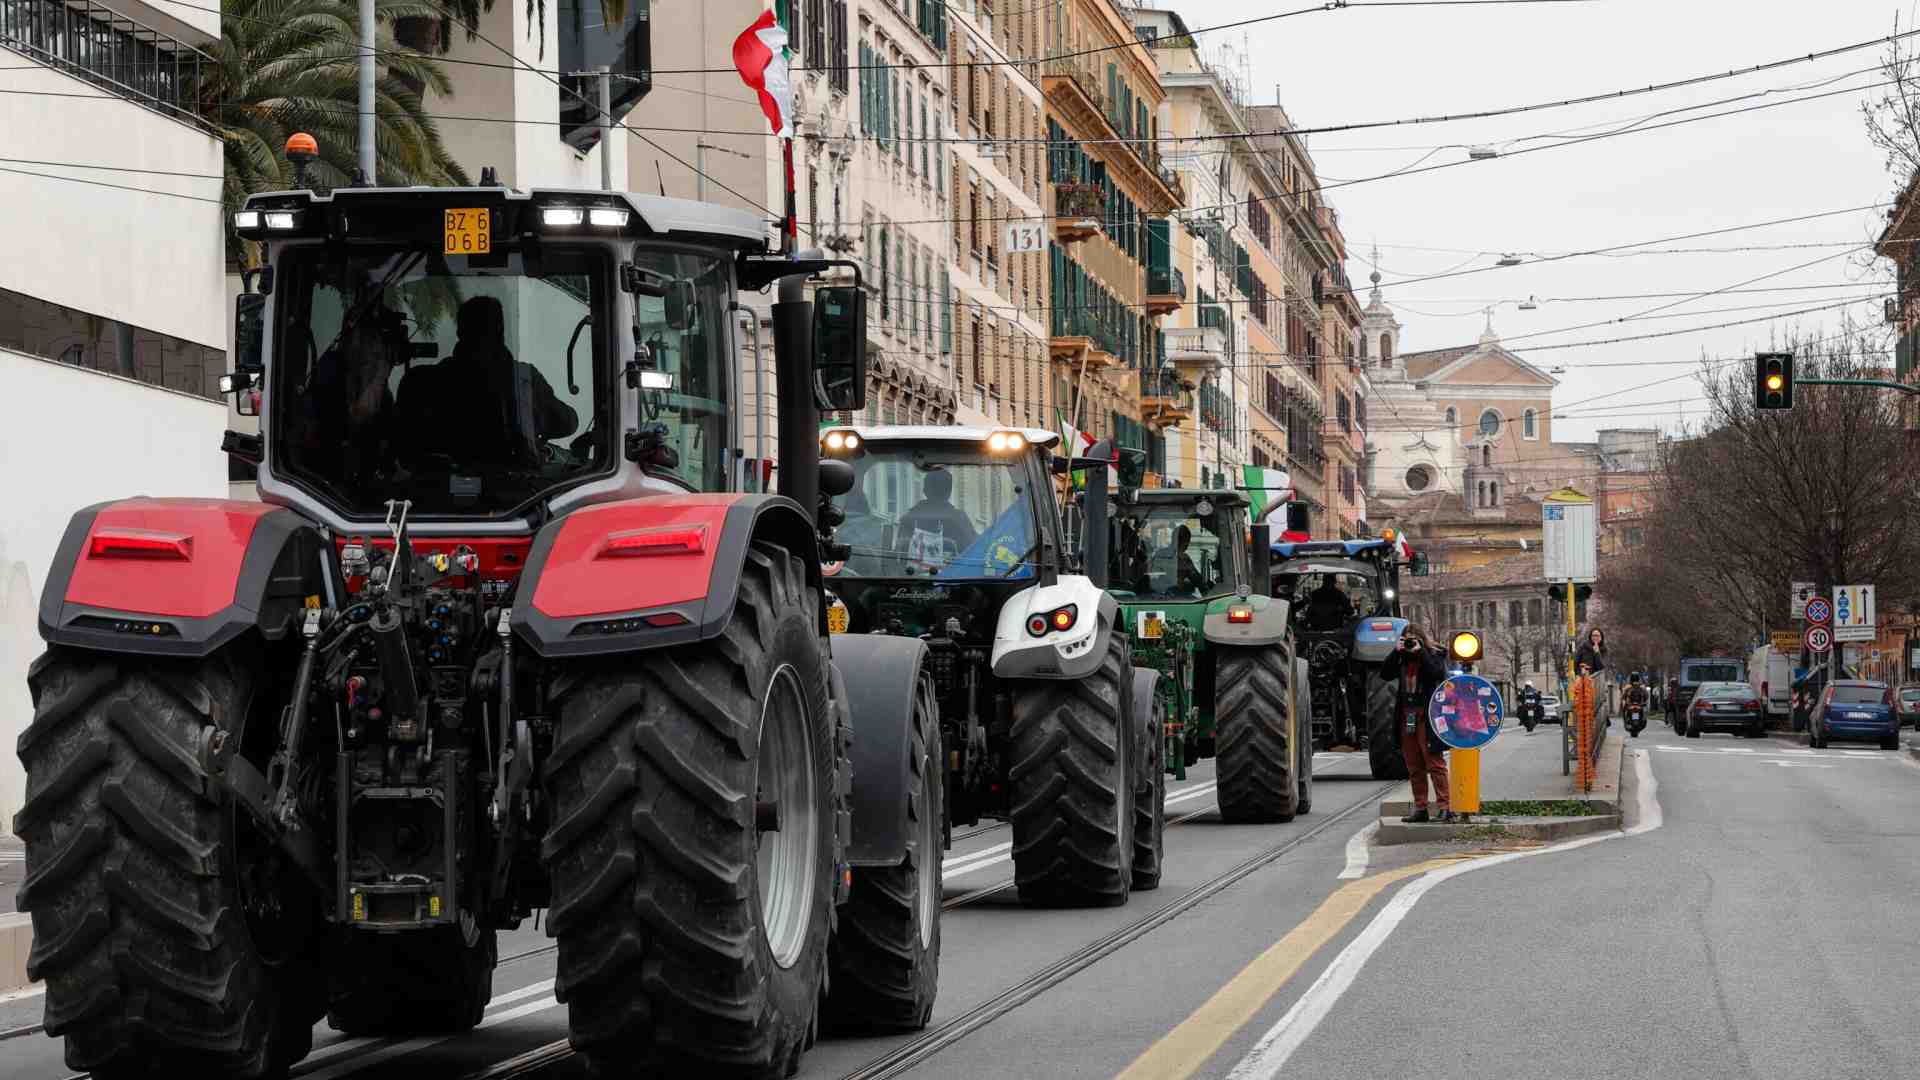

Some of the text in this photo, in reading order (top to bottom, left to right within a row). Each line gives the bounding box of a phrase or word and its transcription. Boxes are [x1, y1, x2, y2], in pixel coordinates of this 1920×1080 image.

[447, 213, 466, 231] BZ
[1011, 227, 1042, 250] 131
[1811, 630, 1826, 646] 30
